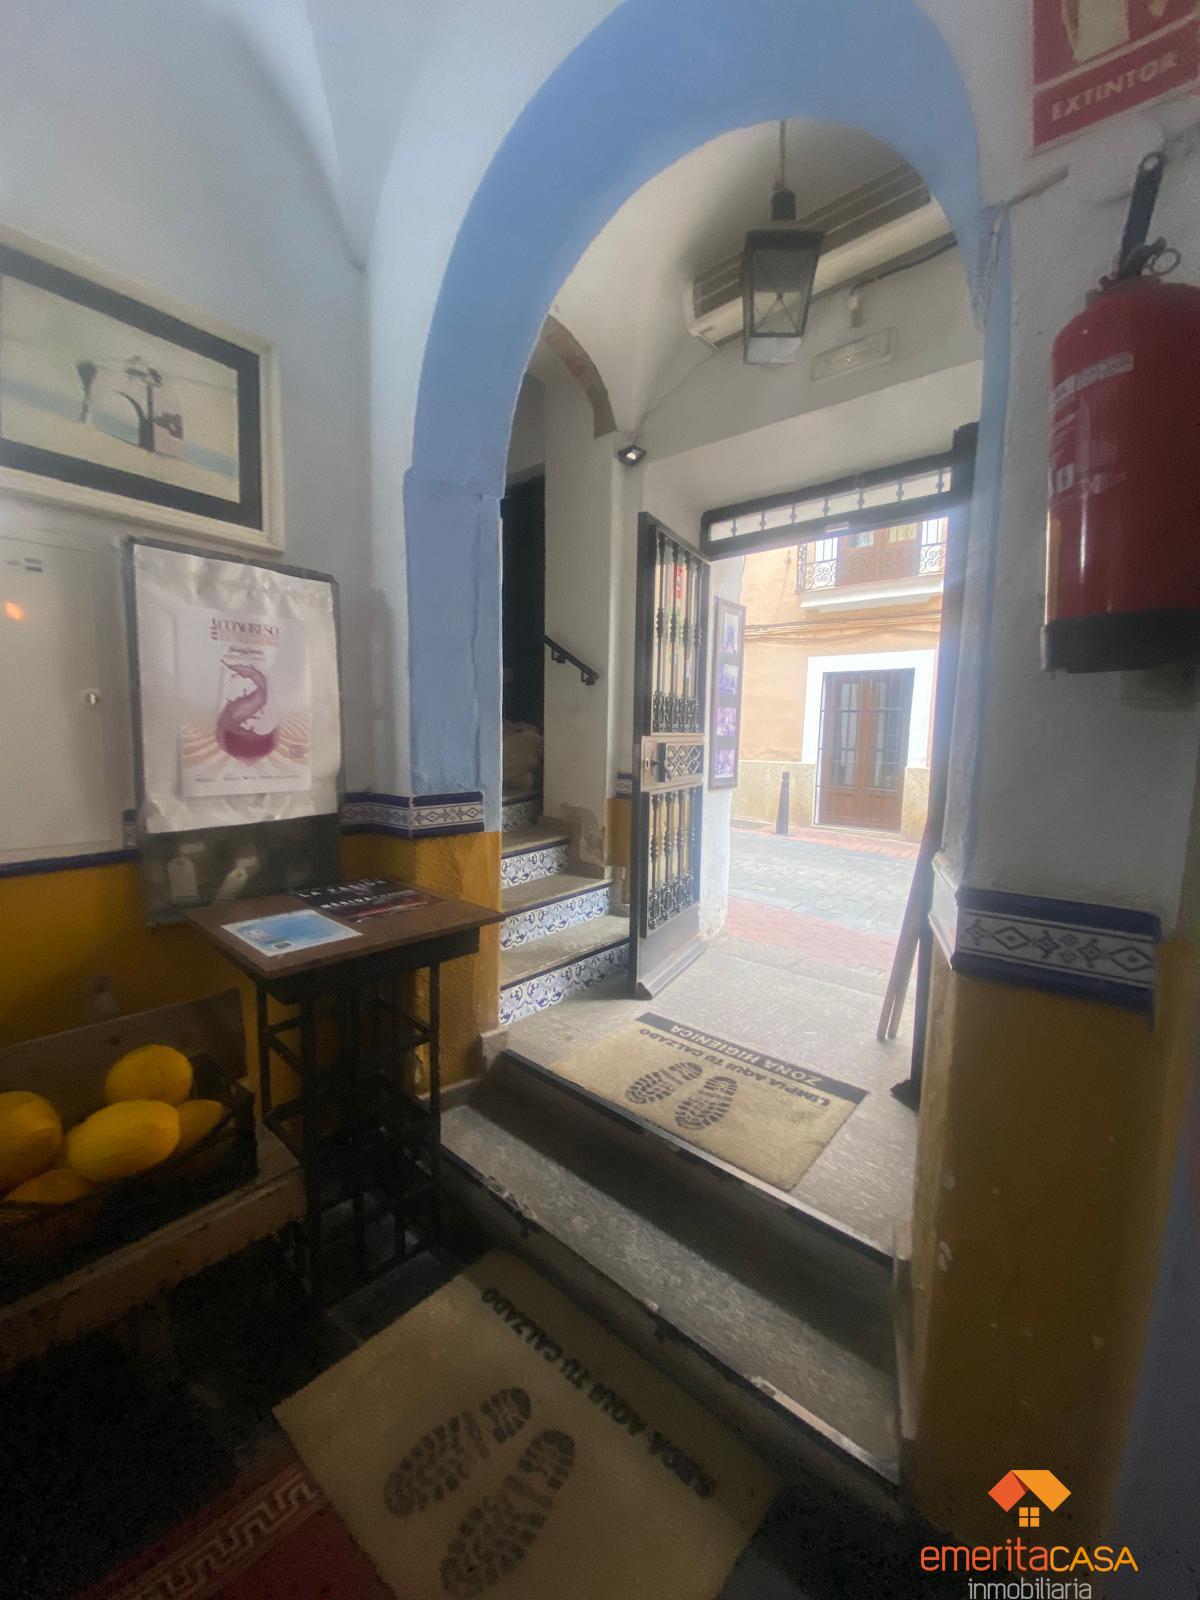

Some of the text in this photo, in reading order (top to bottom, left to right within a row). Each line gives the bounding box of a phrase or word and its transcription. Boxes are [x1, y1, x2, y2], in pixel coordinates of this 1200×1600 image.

[1050, 51, 1177, 122] EXTINTOR
[639, 1028, 704, 1057] CALZADO
[670, 1025, 823, 1086] ZONA HIGIENICA
[703, 1055, 724, 1067] TU
[481, 1287, 563, 1364] CALZADO
